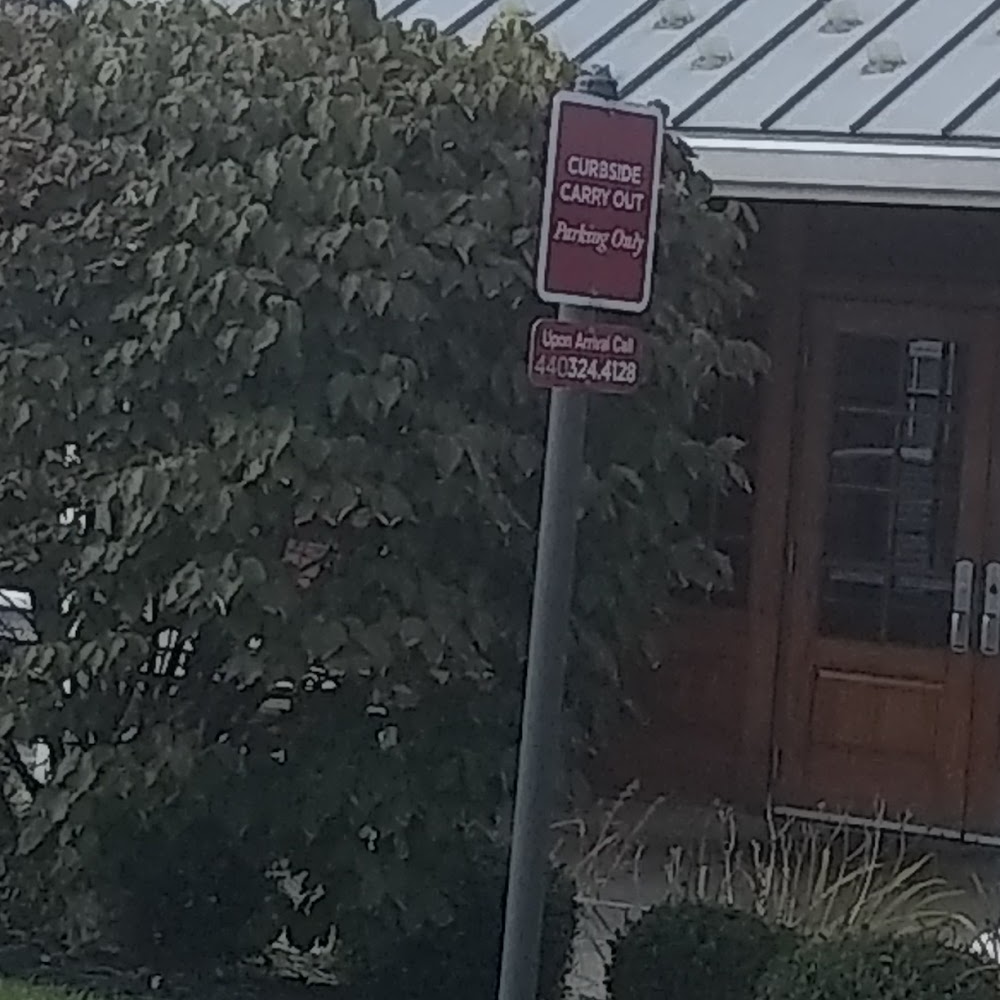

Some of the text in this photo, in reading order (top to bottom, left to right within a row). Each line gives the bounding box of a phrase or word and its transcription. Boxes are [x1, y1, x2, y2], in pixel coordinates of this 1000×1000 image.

[567, 155, 642, 185] CURBSIDE
[560, 182, 645, 212] CARRY OUT
[553, 220, 645, 258] Parking Only
